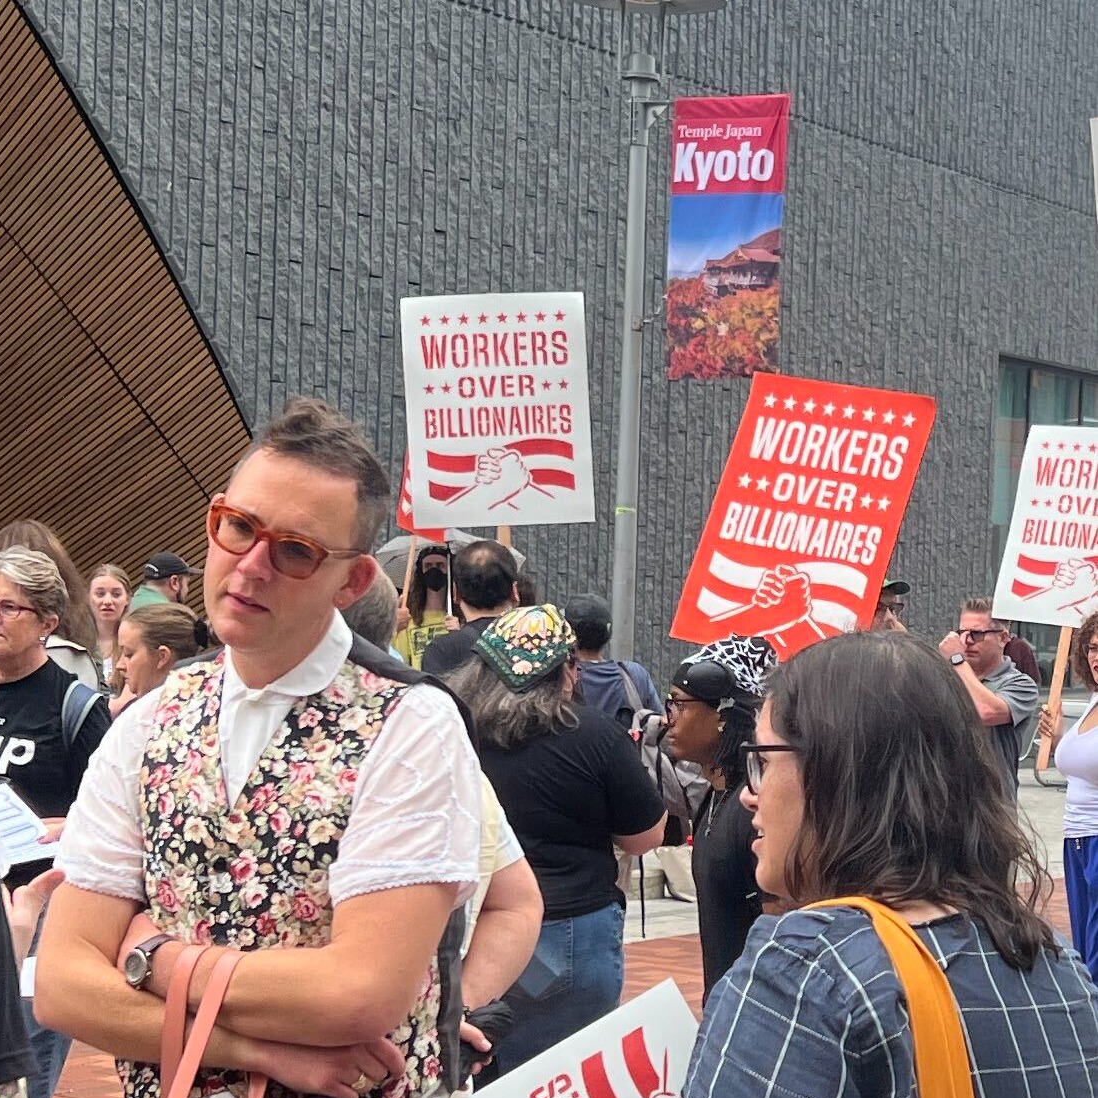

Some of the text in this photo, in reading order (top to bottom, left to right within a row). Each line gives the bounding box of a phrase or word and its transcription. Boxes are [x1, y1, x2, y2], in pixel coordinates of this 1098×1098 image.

[678, 124, 762, 140] Temple Japan
[673, 141, 775, 191] Kyoto
[420, 330, 569, 370] WORKERS
[458, 374, 535, 399] OVER
[424, 404, 573, 440] BILLIONAIRES
[749, 416, 909, 481] WORKERS
[773, 472, 857, 512] OVER
[1035, 456, 1098, 491] WOR
[719, 501, 882, 566] BILLIONAIRES
